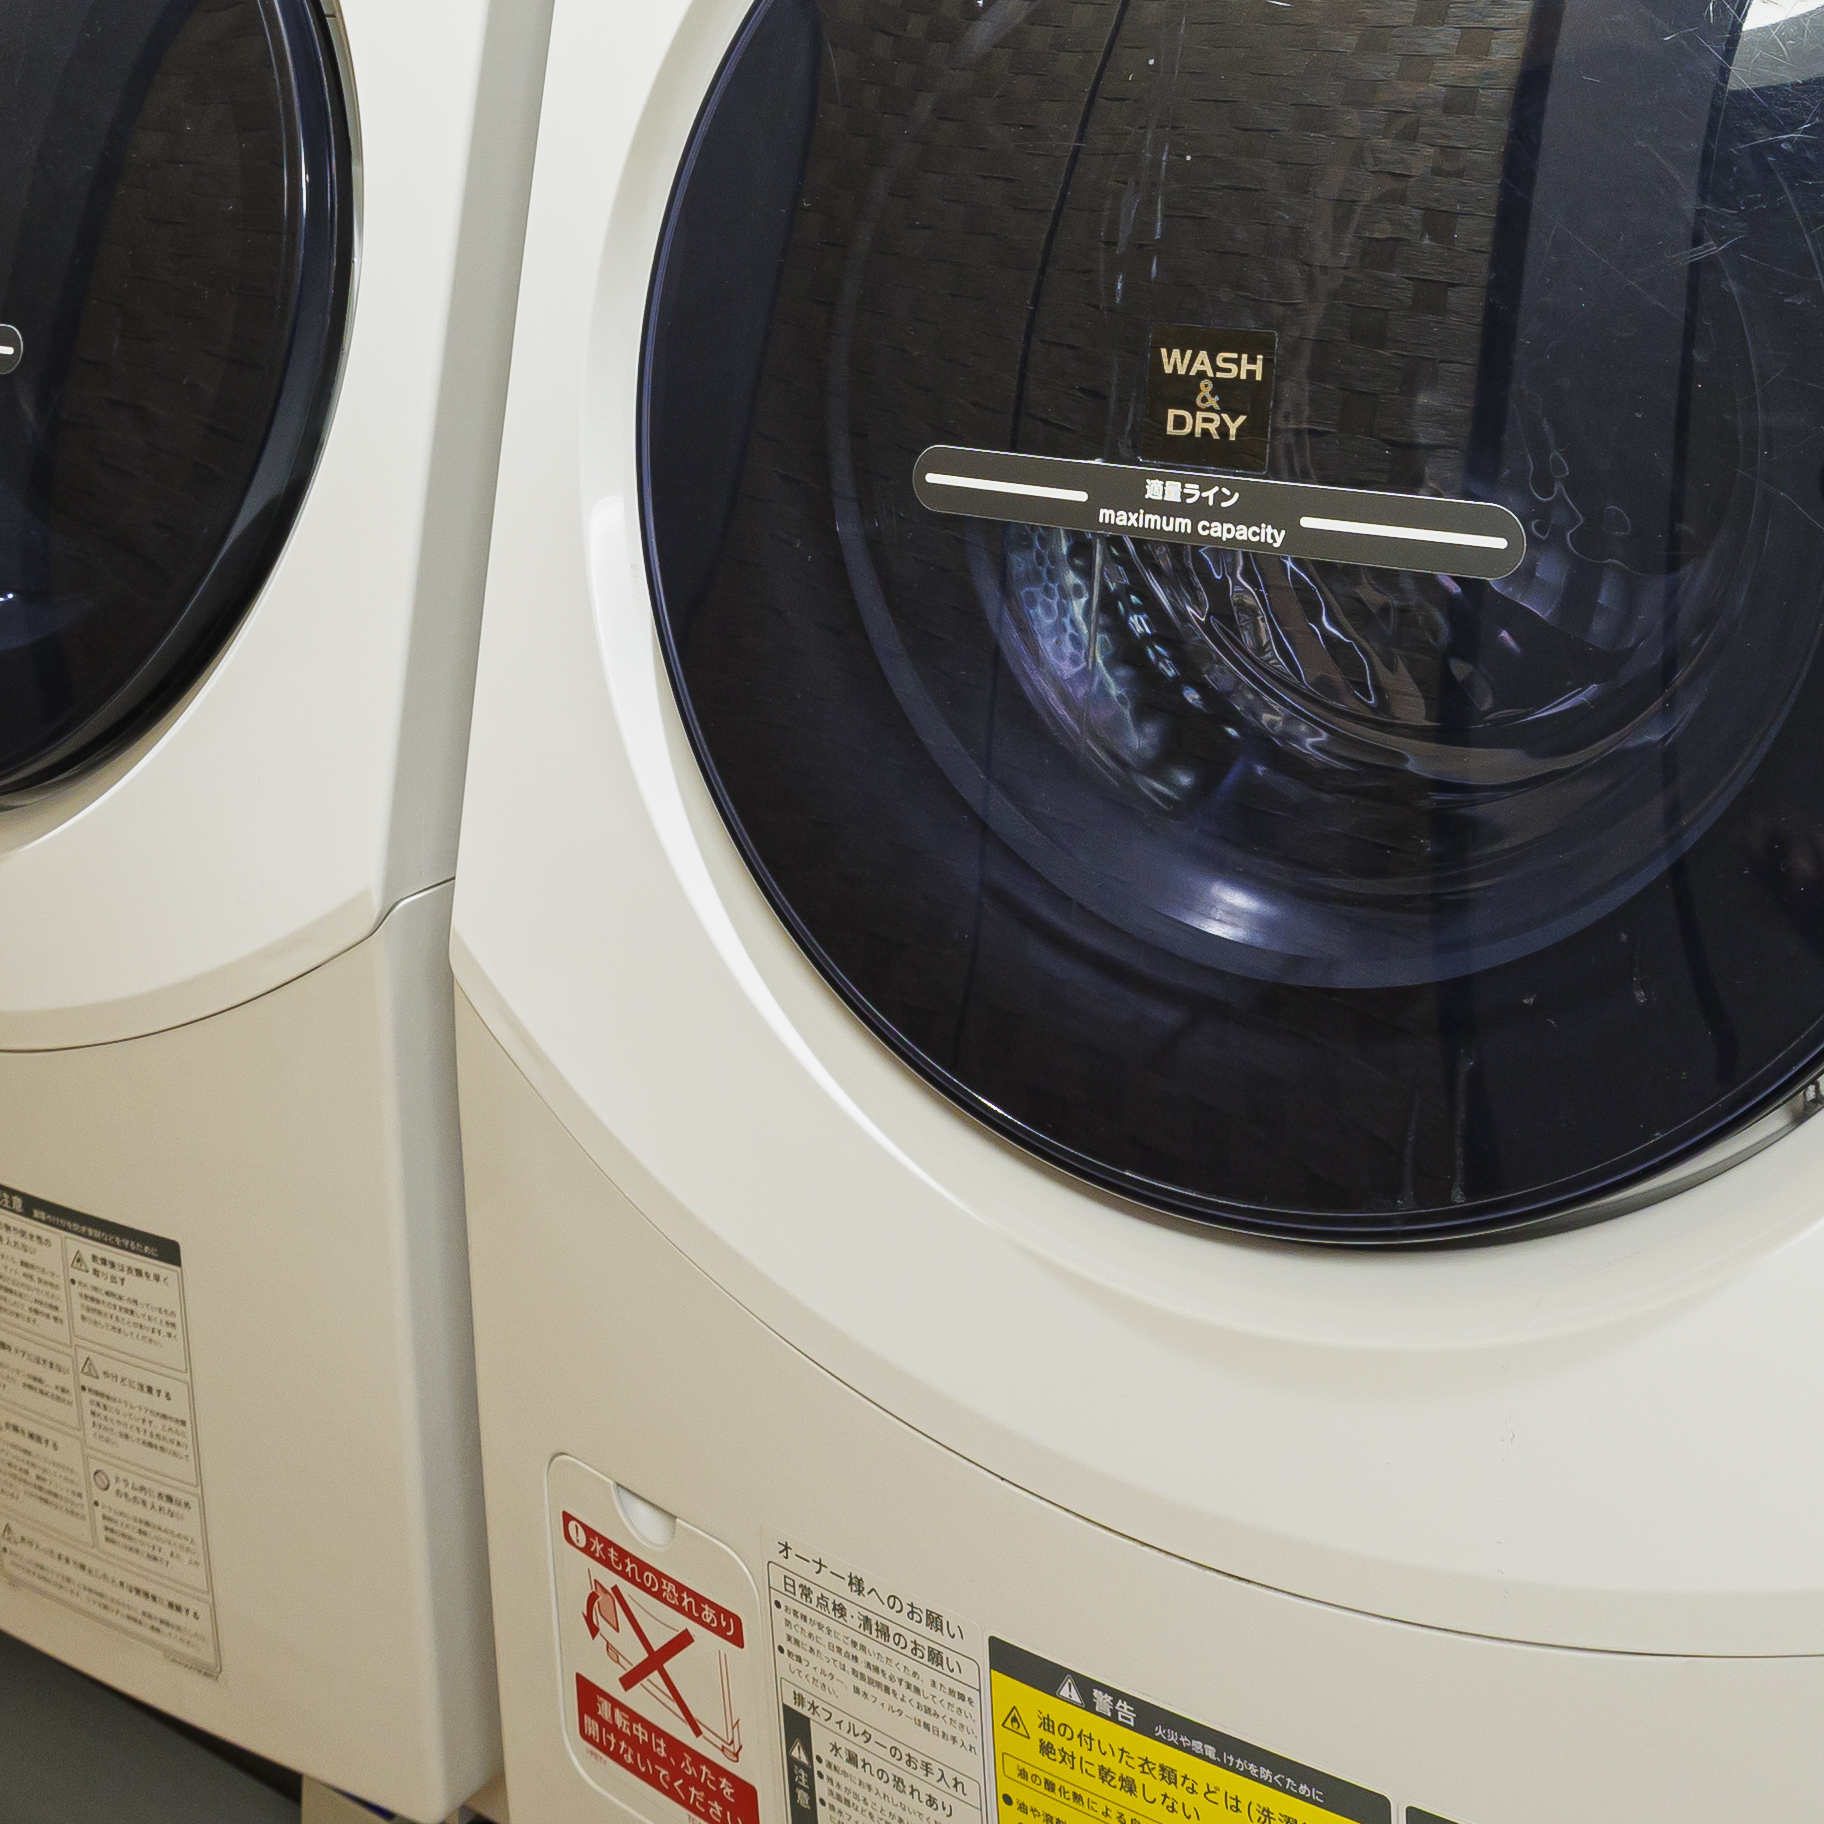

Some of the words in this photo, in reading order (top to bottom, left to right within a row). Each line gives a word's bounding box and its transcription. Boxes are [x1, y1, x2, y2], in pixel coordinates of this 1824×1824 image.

[1160, 348, 1264, 383] WASH
[1195, 379, 1222, 411] &
[1165, 409, 1249, 442] DRY
[1143, 478, 1241, 509] 適量ライン
[1098, 506, 1193, 536] maximum
[1196, 517, 1287, 549] capacity
[777, 1540, 964, 1641] オーナー様へのお願い
